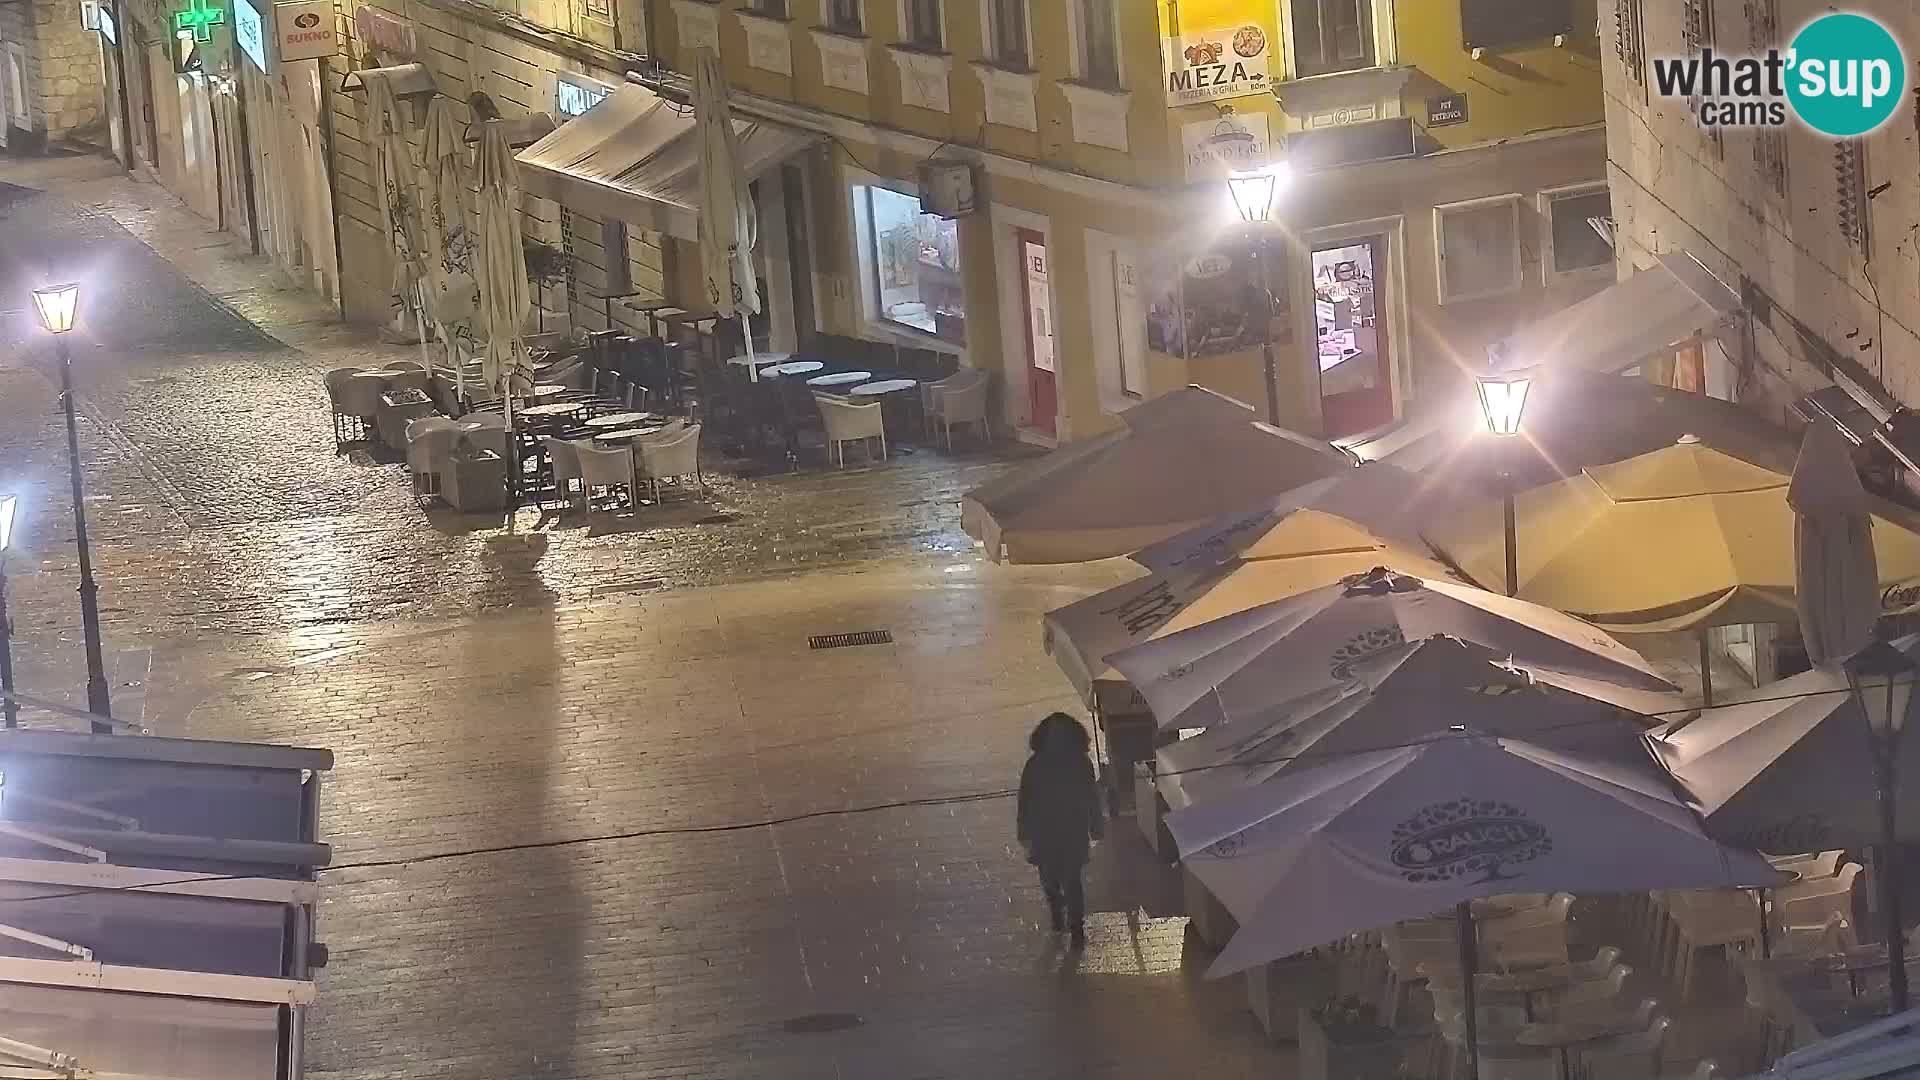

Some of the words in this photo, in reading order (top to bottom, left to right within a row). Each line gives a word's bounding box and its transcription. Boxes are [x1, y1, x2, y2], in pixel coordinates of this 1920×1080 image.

[287, 30, 331, 44] SUKNO
[1169, 62, 1248, 92] MEZA
[1219, 83, 1241, 94] GRILL
